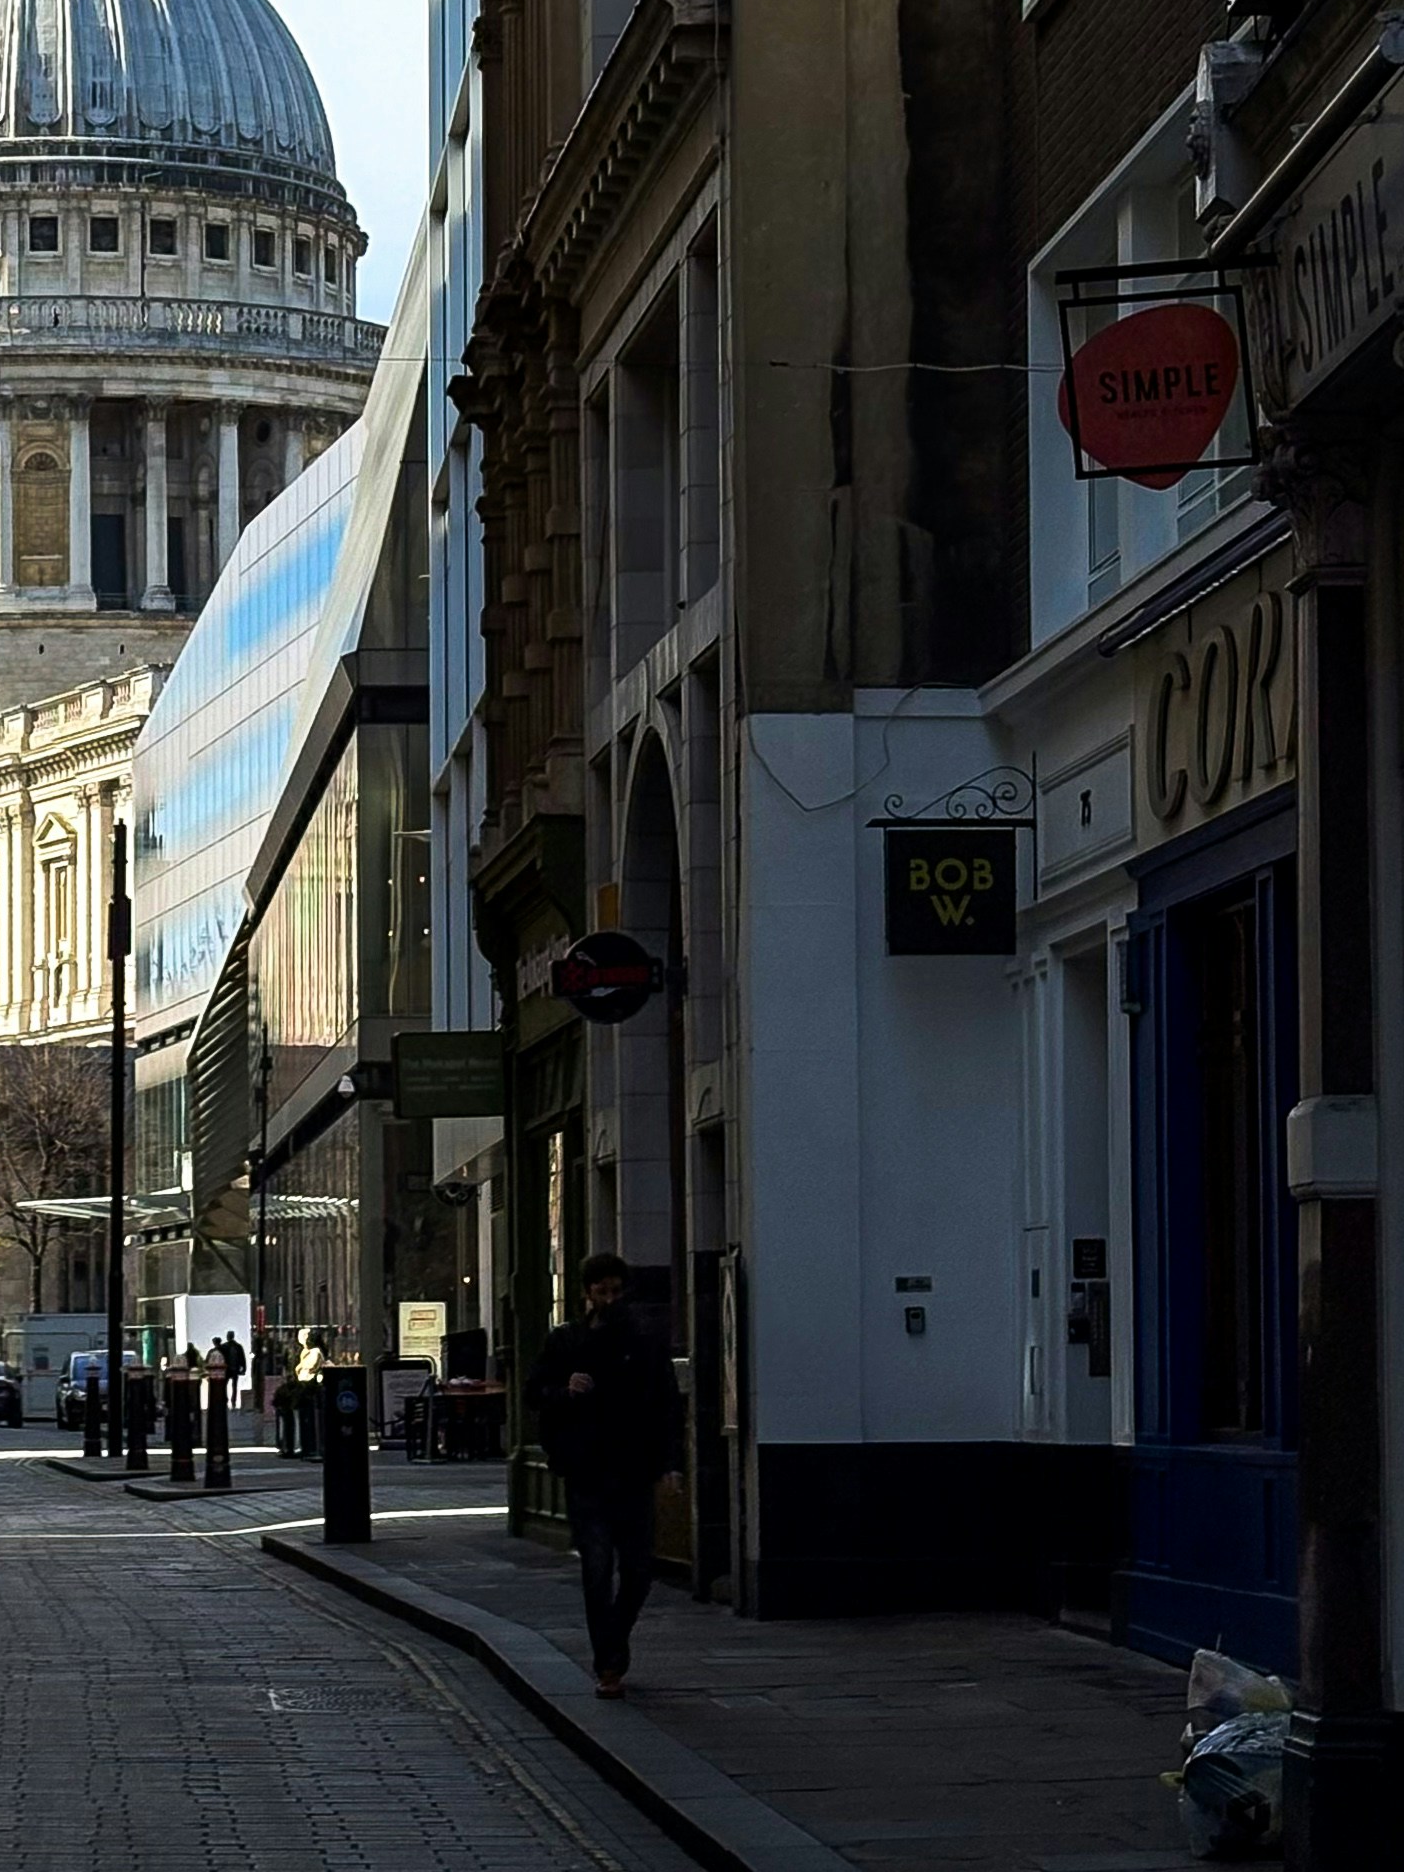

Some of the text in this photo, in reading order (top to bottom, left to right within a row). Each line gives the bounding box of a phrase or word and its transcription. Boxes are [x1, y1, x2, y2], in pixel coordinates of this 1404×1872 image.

[1294, 157, 1395, 374] SIMPLE
[1099, 361, 1222, 405] SIMPLE
[1147, 590, 1296, 820] COR
[909, 857, 995, 891] BOB
[930, 894, 975, 927] W.
